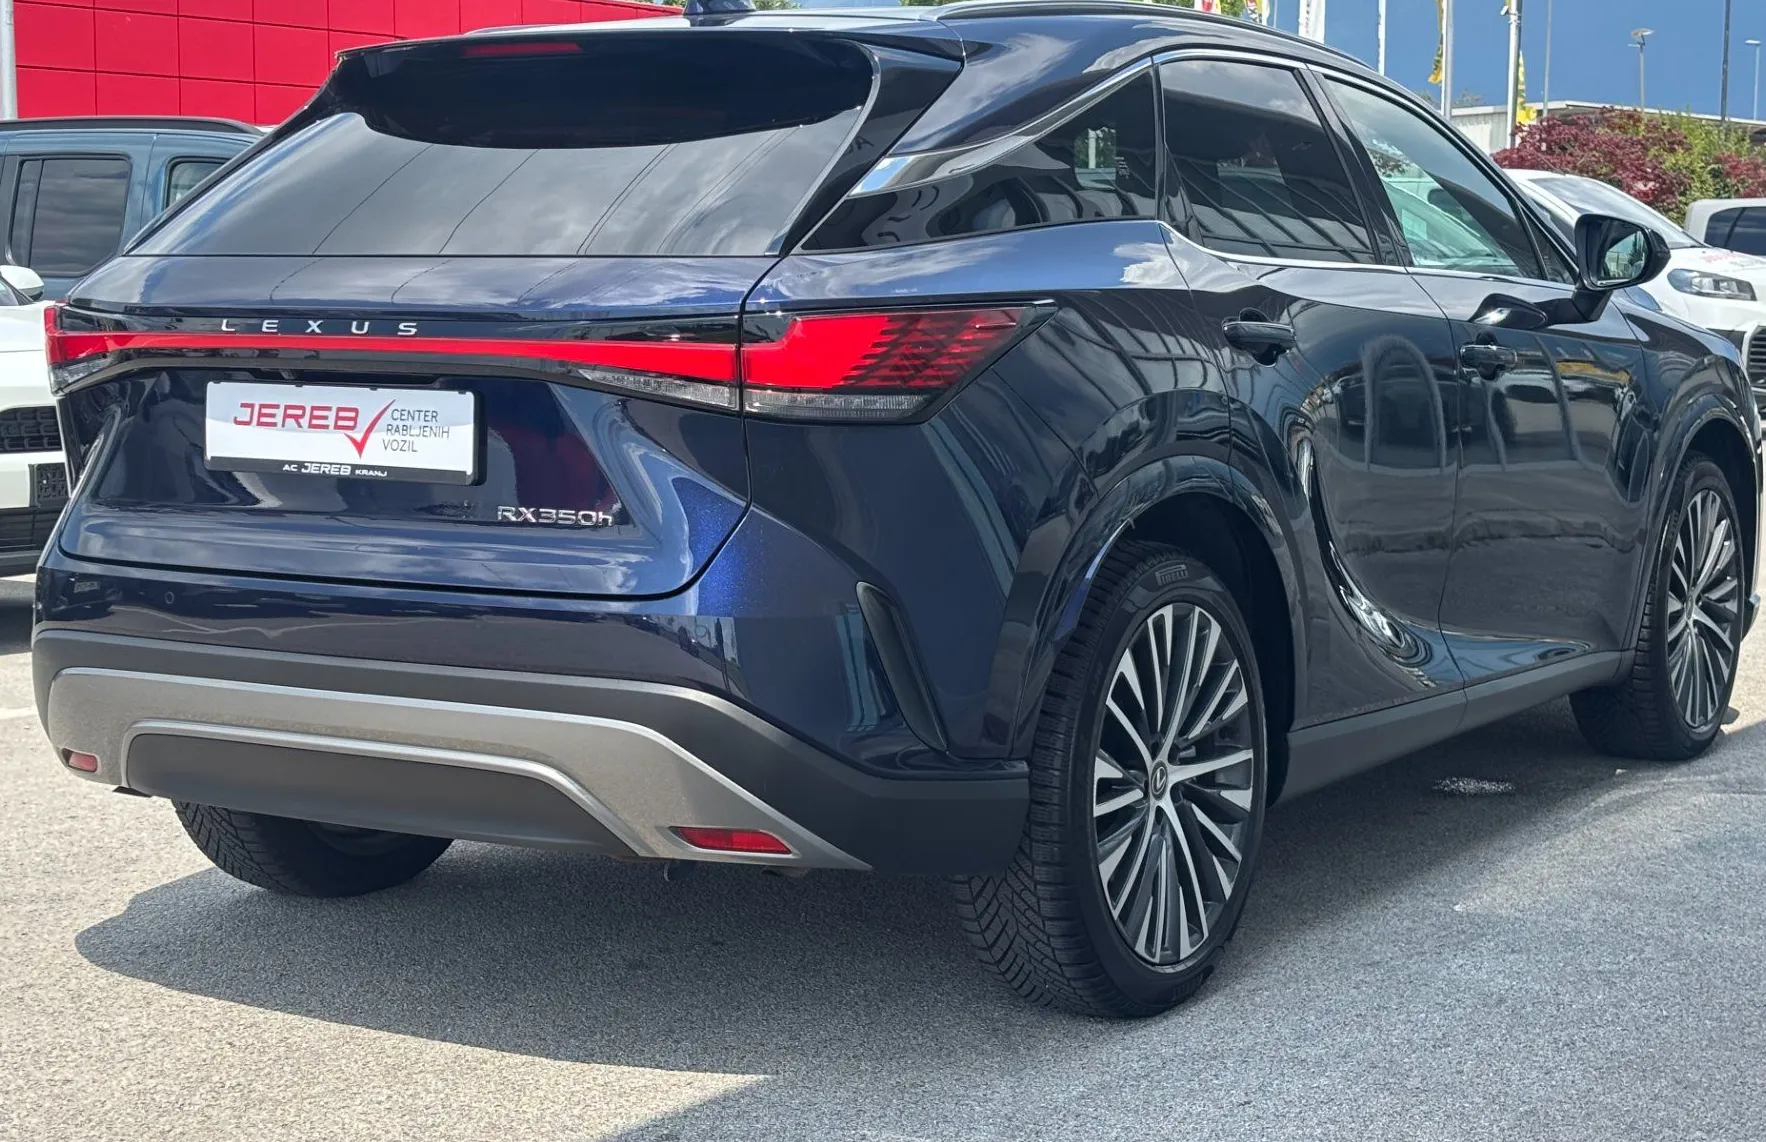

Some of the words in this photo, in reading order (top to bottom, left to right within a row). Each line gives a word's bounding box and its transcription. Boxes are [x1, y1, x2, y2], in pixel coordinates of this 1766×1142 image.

[220, 319, 418, 336] LEXUS
[233, 402, 360, 431] JEREB
[391, 409, 439, 423] CENTER
[386, 423, 450, 439] RABLJENIH
[382, 438, 418, 452] VOZIL
[282, 464, 298, 472] AC
[301, 462, 351, 475] JEREB
[355, 469, 387, 477] KRANJ
[497, 506, 613, 526] RX350h
[1155, 564, 1189, 586] PIRELLI
